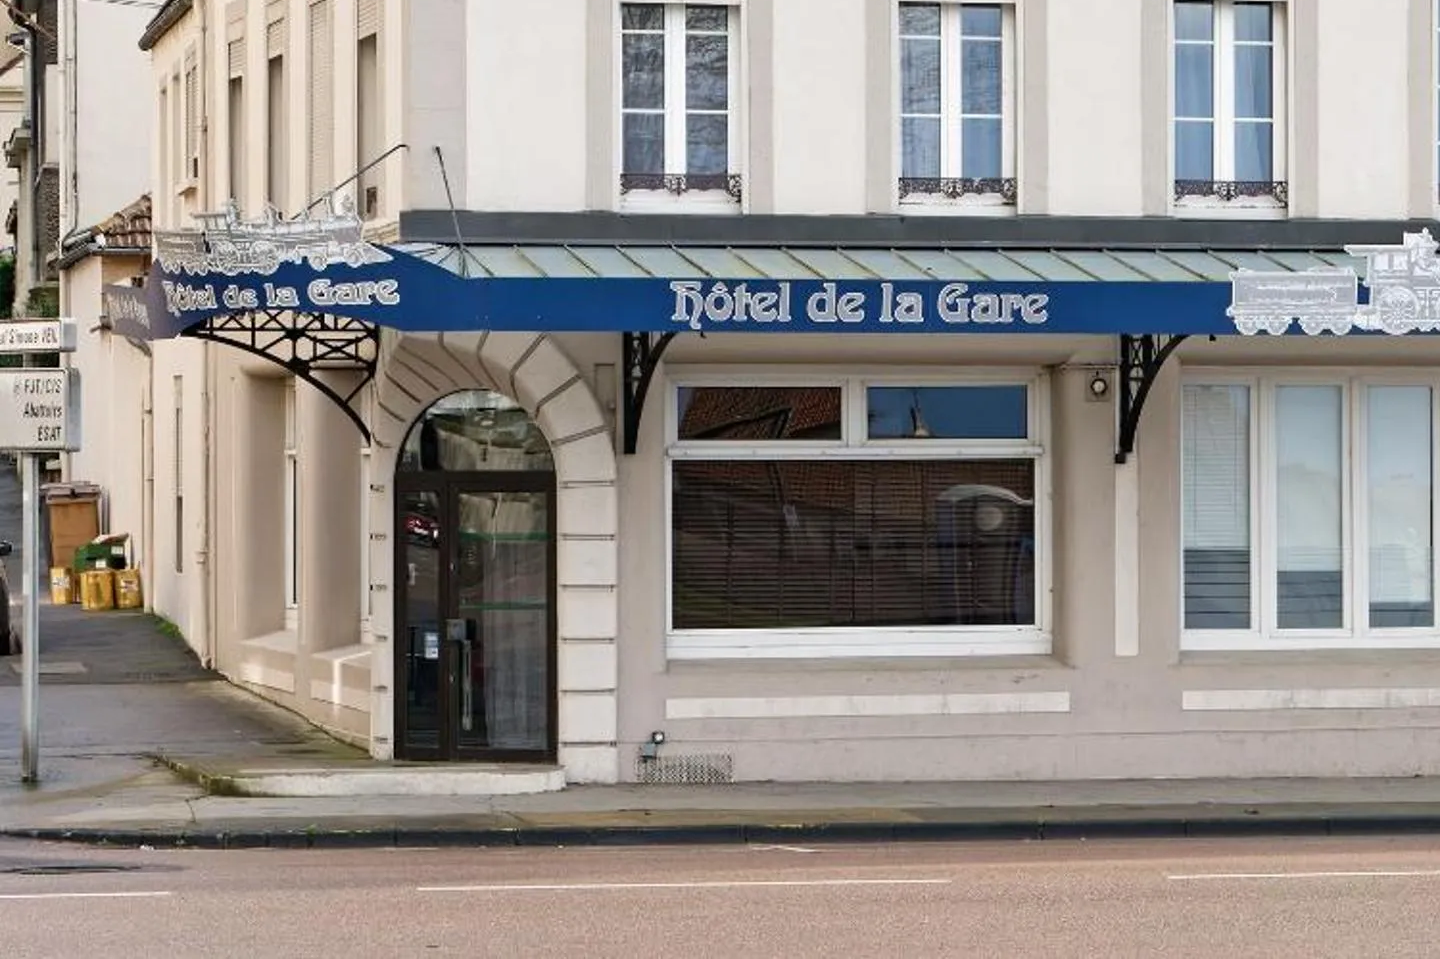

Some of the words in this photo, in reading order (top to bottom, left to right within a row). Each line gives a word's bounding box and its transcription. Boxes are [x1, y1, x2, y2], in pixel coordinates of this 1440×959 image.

[161, 280, 218, 318] Hôtel
[223, 284, 259, 309] de
[262, 282, 300, 308] la
[306, 278, 401, 306] Gare
[669, 280, 792, 330] Hôtel
[806, 282, 866, 323] de
[878, 282, 925, 324] la
[937, 282, 1050, 325] Gare
[38, 426, 62, 441] ESAT
